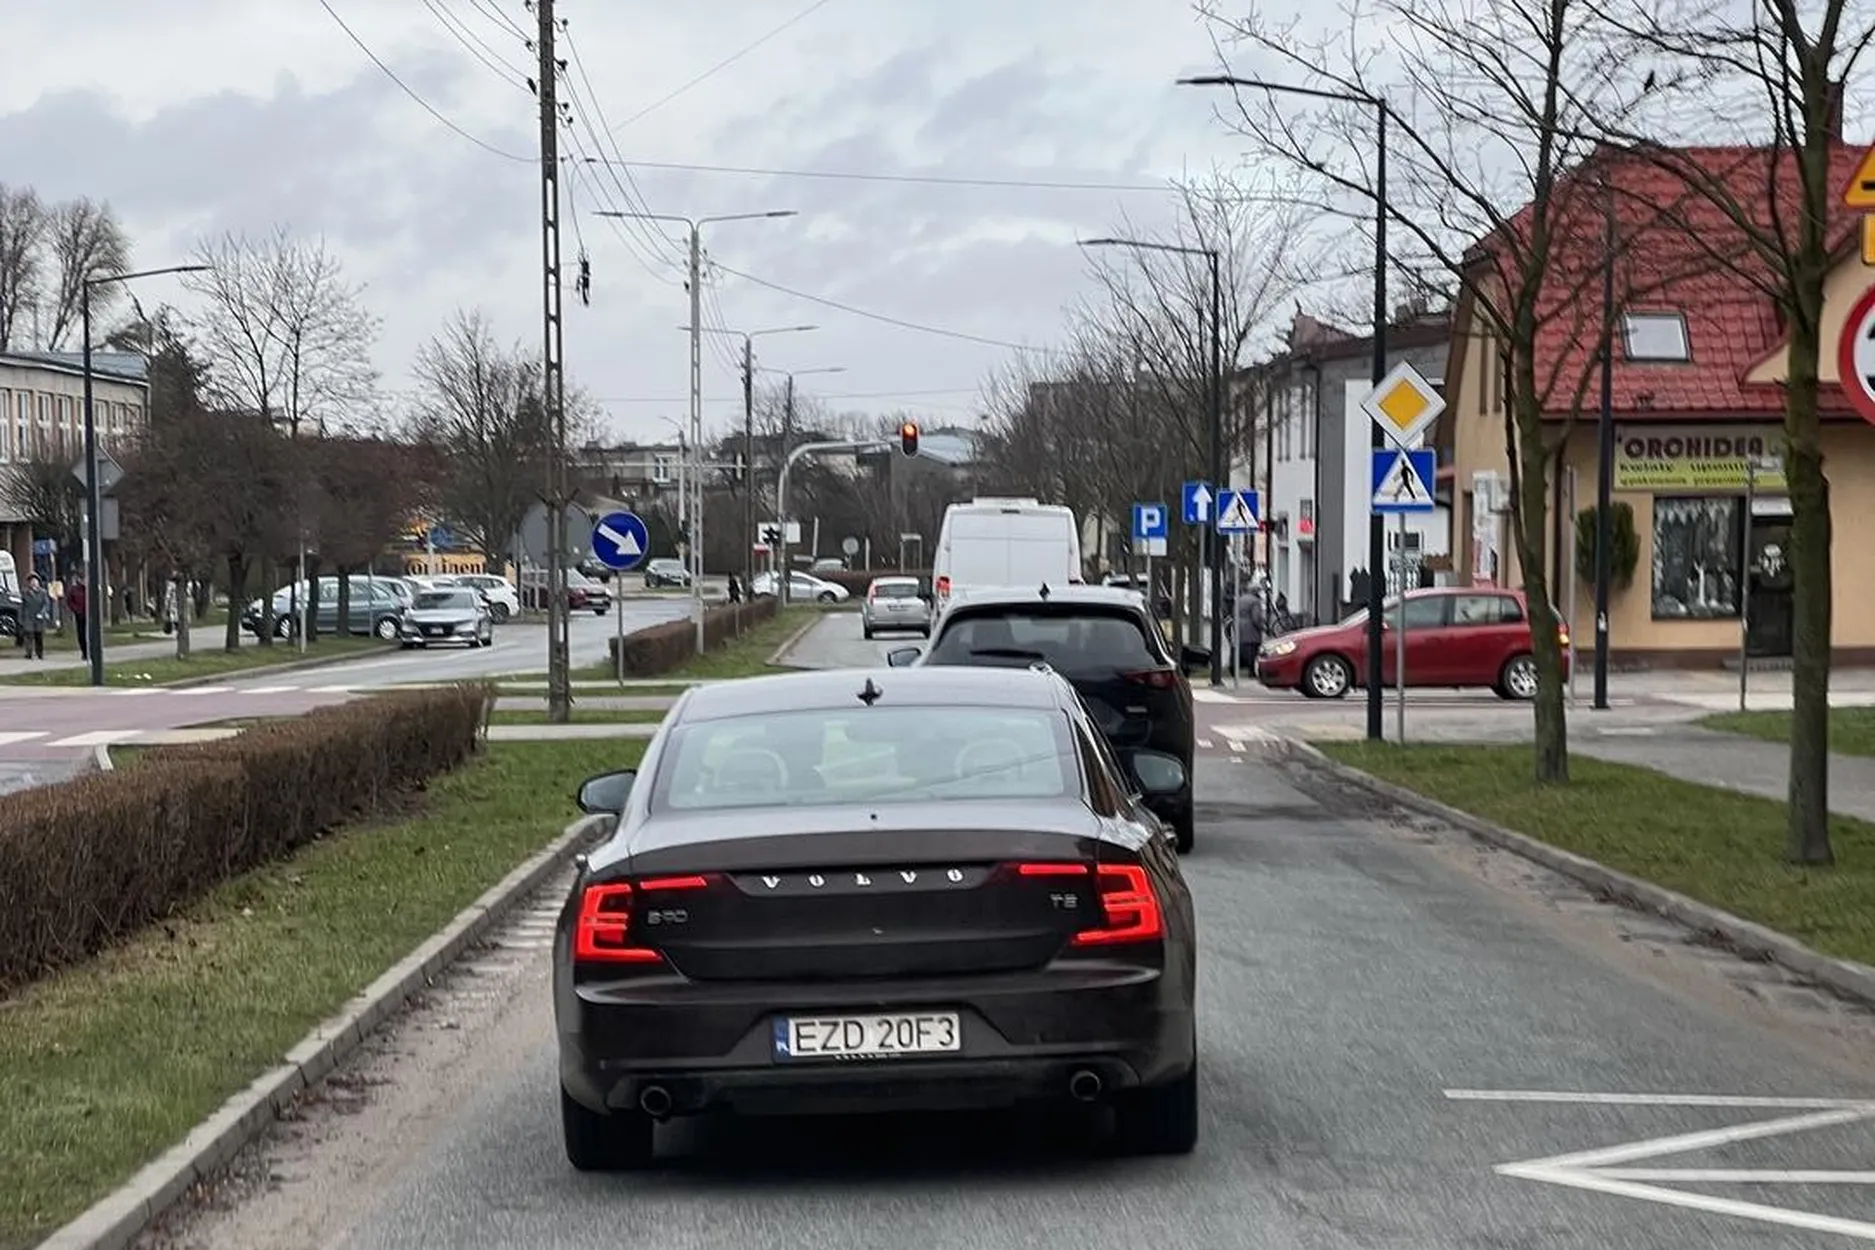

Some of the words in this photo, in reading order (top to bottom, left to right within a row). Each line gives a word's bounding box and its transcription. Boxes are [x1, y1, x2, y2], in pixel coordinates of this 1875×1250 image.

[1141, 508, 1161, 535] P
[762, 869, 964, 888] VOLVO
[795, 1020, 865, 1052] EZD
[877, 1016, 955, 1049] 20F3
